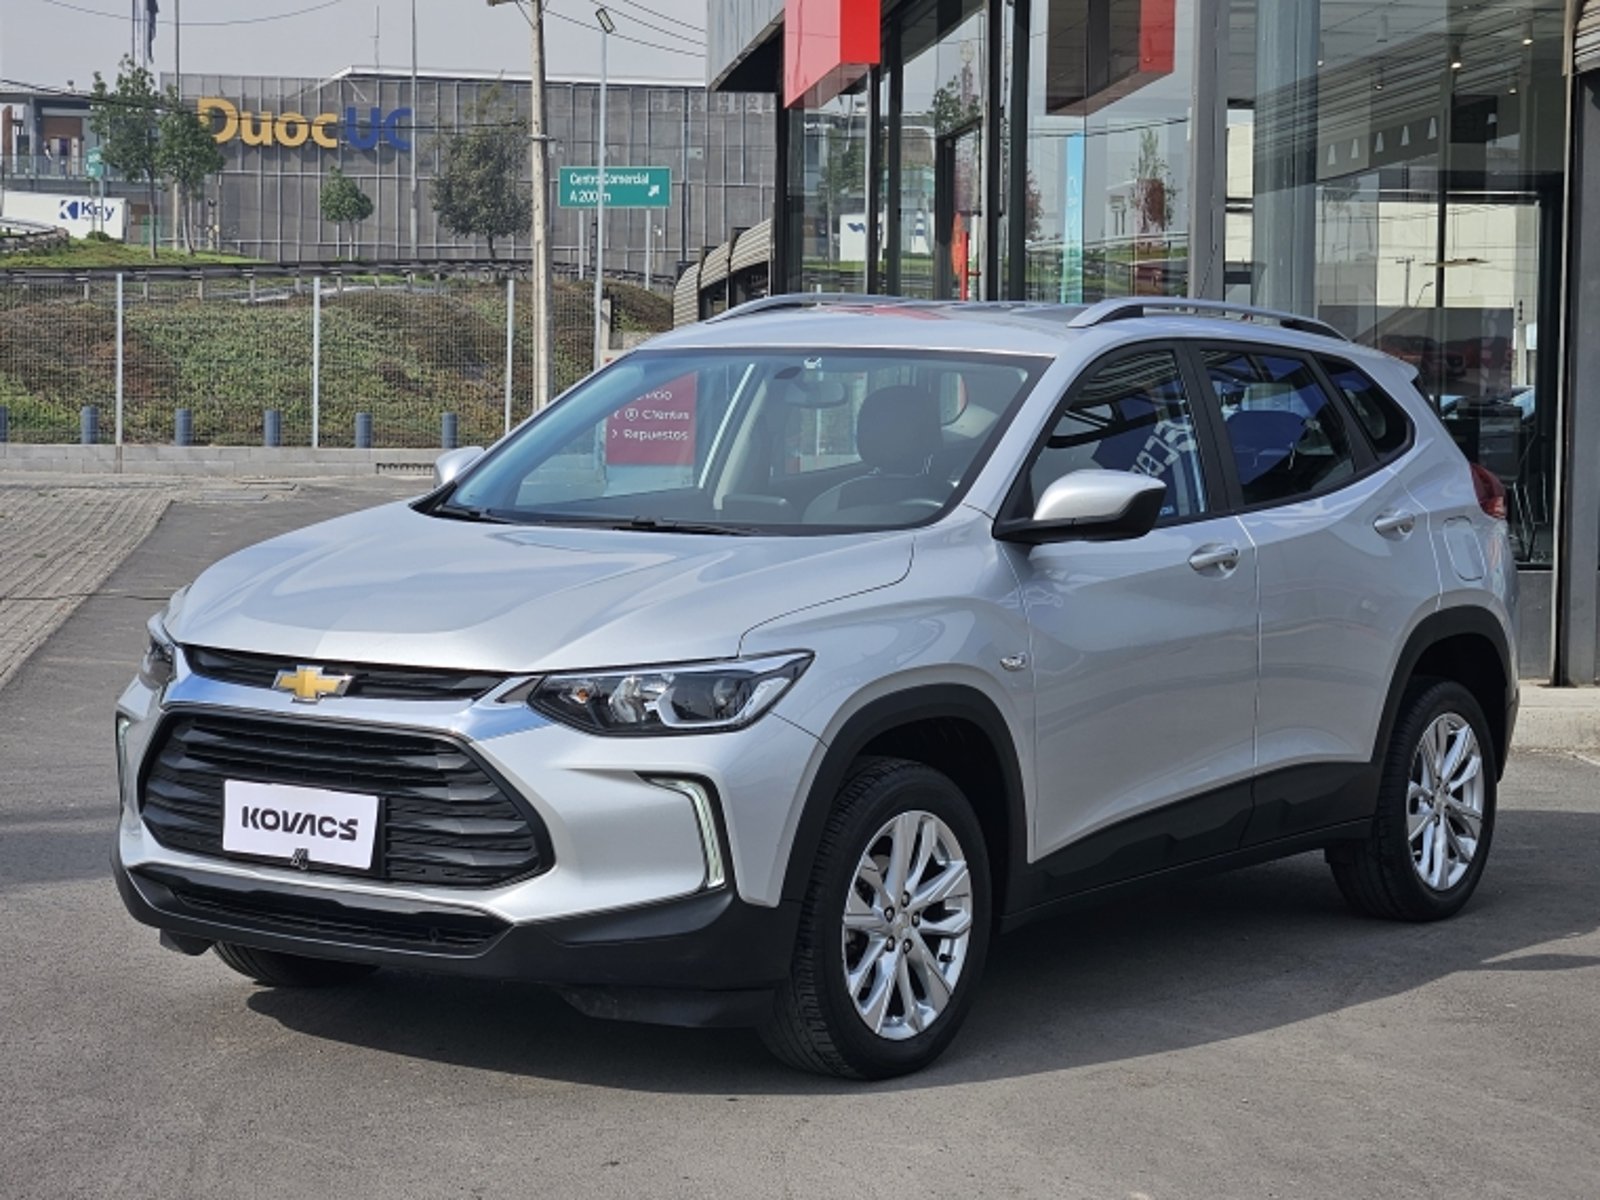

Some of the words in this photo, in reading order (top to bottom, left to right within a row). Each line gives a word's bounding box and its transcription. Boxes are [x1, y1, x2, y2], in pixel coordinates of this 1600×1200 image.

[198, 97, 338, 148] Duoc
[346, 107, 411, 150] UC
[569, 190, 578, 202] A
[624, 429, 688, 441] Repuestos
[242, 806, 358, 841] KOVACS
